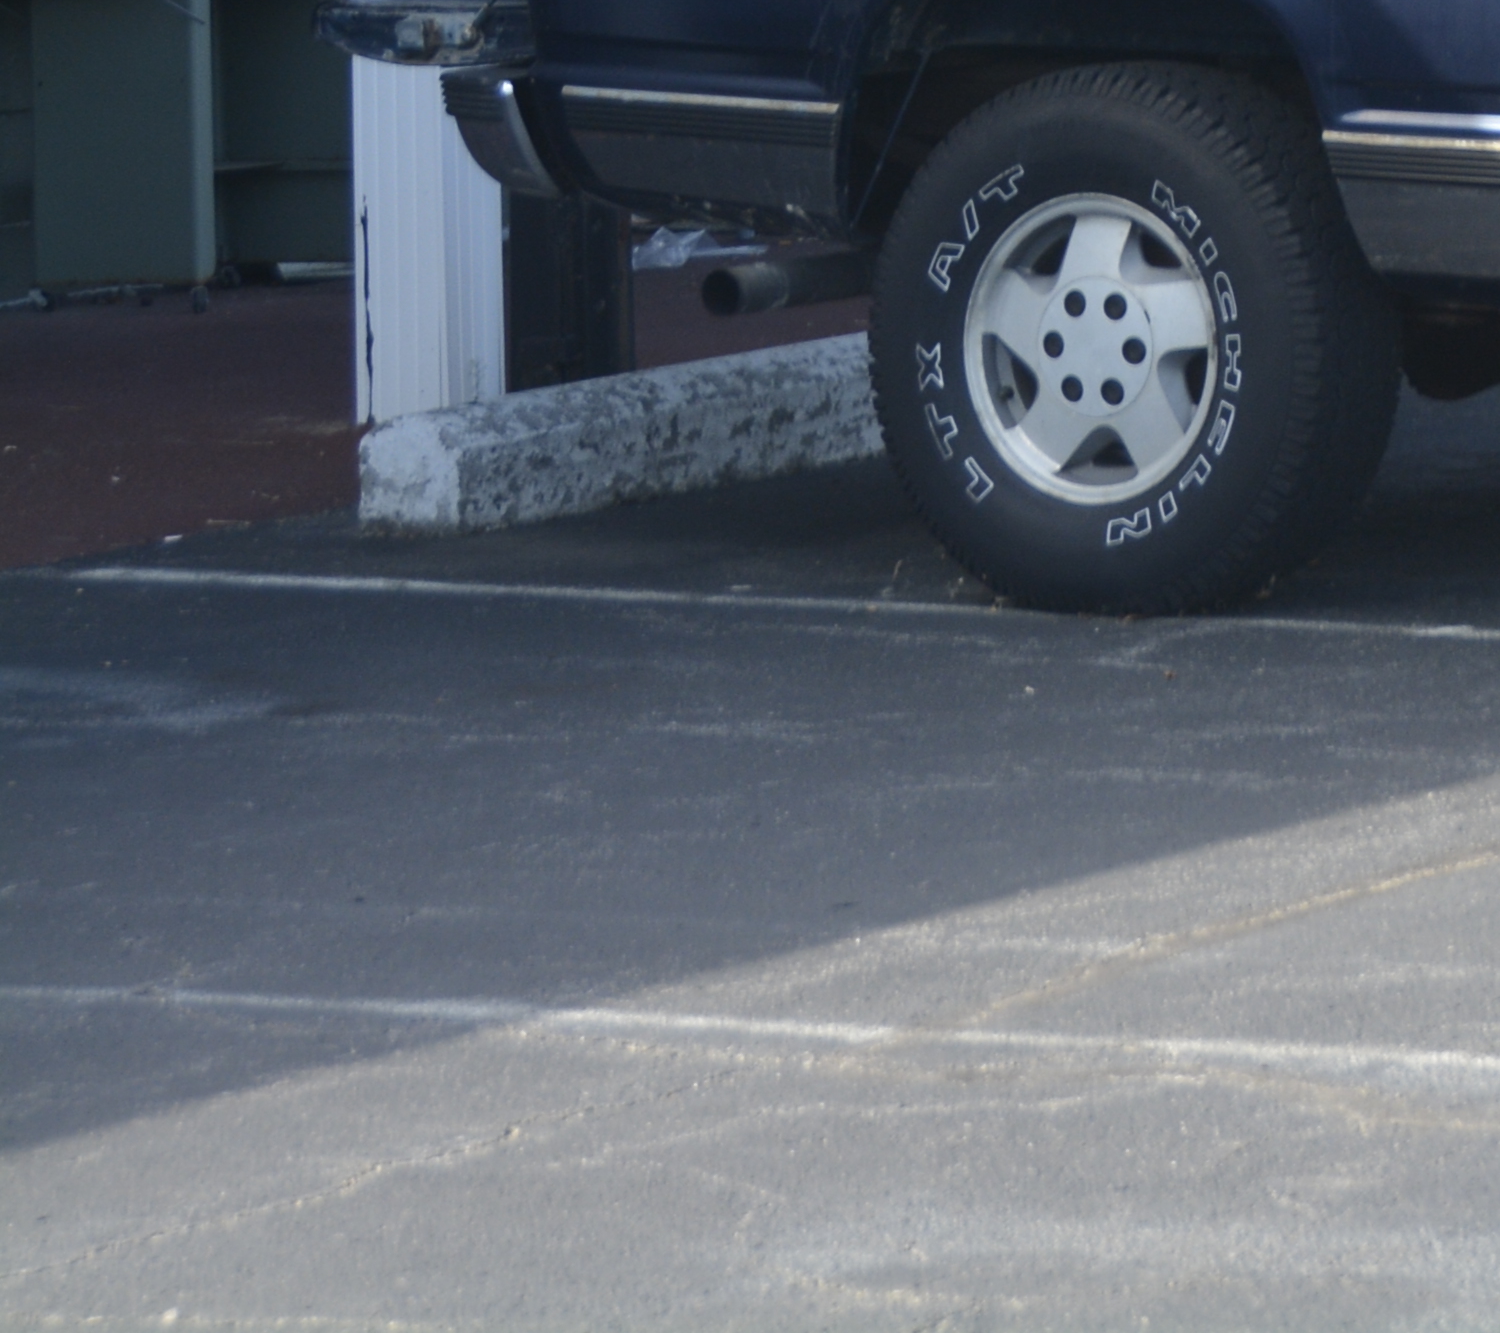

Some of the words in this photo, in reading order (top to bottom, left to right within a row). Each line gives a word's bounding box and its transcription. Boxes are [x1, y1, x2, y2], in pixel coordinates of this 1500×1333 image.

[927, 164, 1025, 292] A/T
[915, 341, 994, 503] LTX
[1106, 179, 1241, 546] MICHELIN
